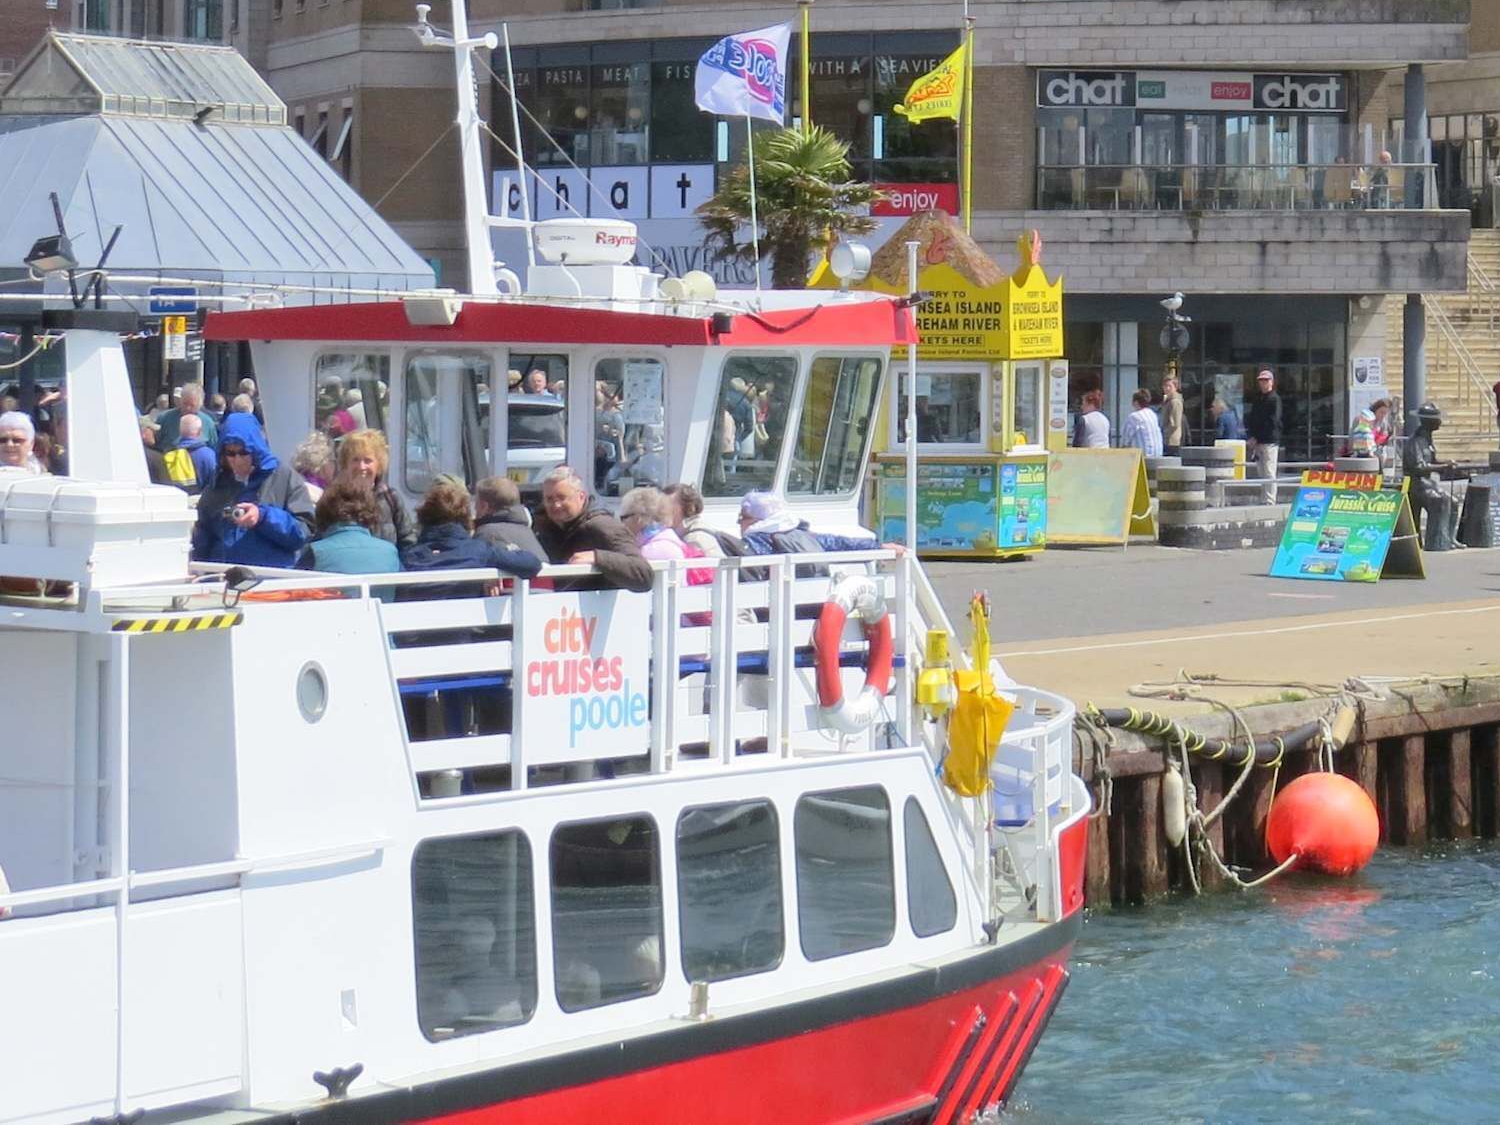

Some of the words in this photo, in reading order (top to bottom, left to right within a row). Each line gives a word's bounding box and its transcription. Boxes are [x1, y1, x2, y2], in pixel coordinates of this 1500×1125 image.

[545, 70, 583, 84] PASTA
[603, 67, 639, 82] MEAT
[666, 65, 690, 79] FIS
[850, 61, 861, 74] A
[1046, 73, 1126, 105] chat
[1214, 85, 1248, 98] enjoy
[1262, 76, 1340, 107] chat
[891, 189, 938, 212] enjoy
[953, 291, 966, 299] TO
[955, 302, 1002, 315] ISLAND
[916, 318, 959, 331] REHAM
[963, 318, 1000, 331] RIVER
[952, 336, 983, 345] HERE
[1307, 471, 1377, 489] PUFFIN
[544, 605, 597, 655] city
[527, 646, 623, 697] cruises
[569, 678, 646, 748] poole
